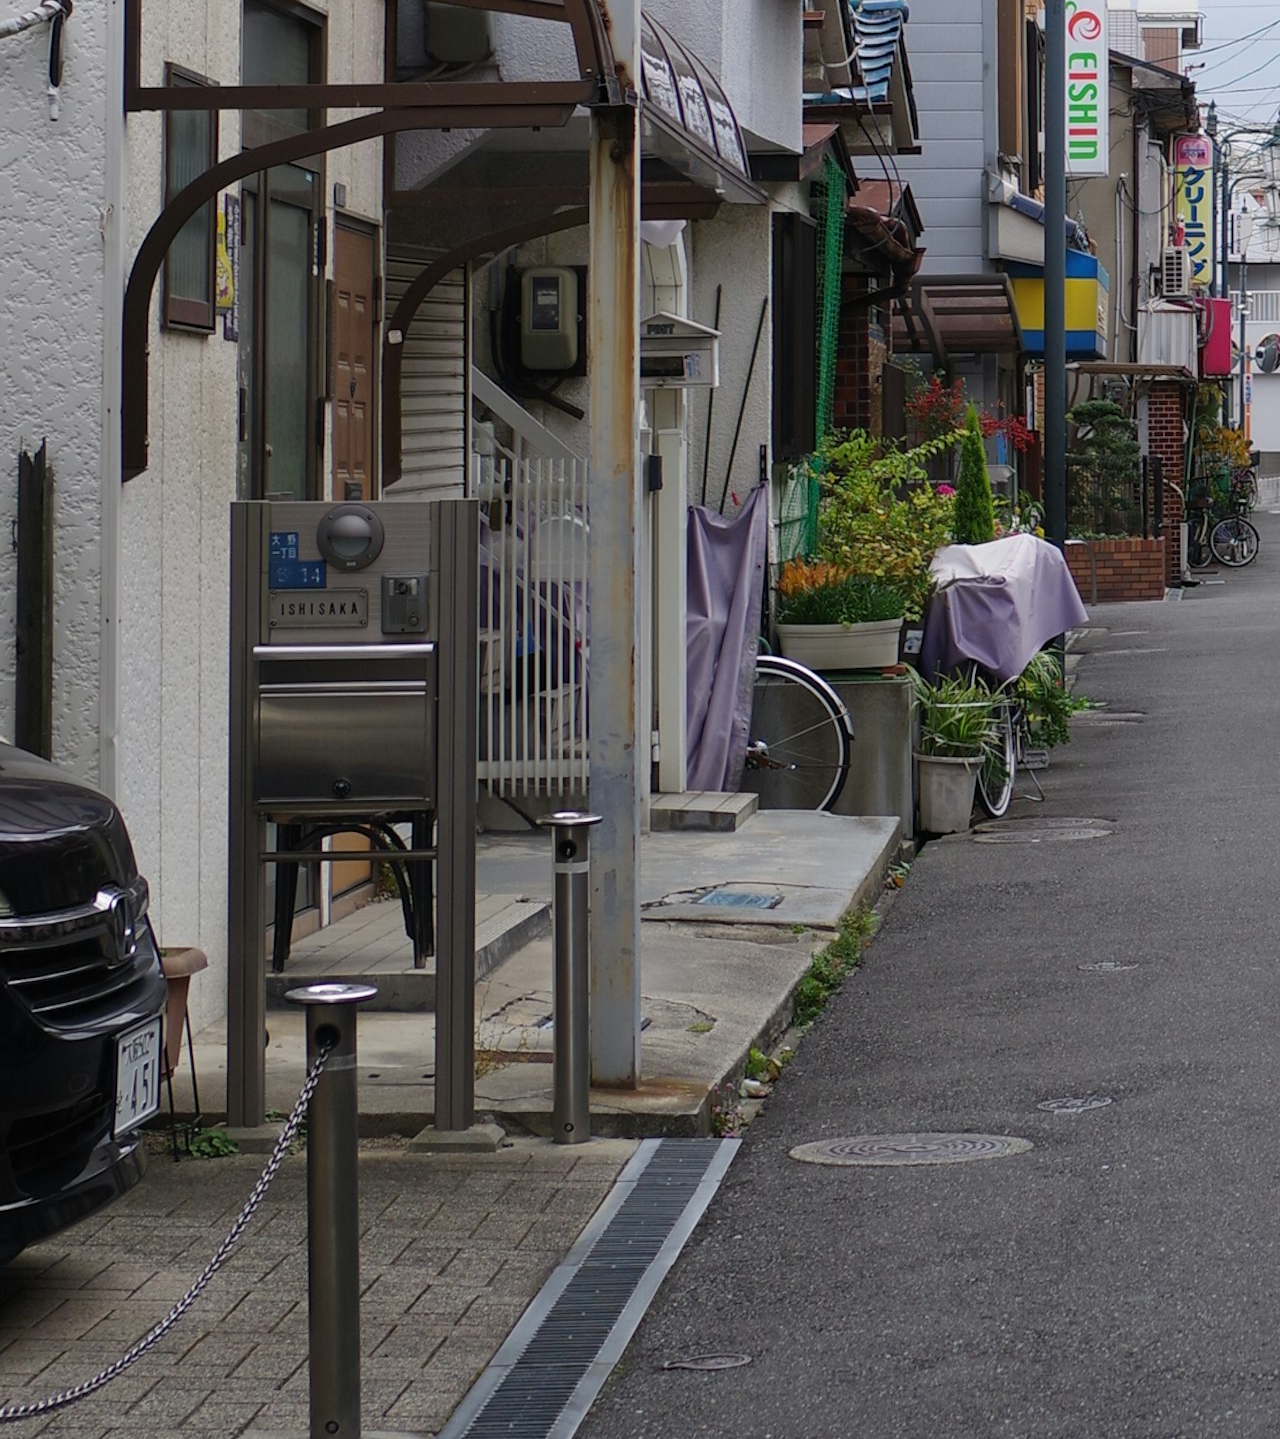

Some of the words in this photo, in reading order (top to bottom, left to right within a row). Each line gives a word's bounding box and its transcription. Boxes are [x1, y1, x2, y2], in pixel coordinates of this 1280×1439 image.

[272, 547, 296, 559] 一丁目
[281, 602, 358, 616] ISHISAKA
